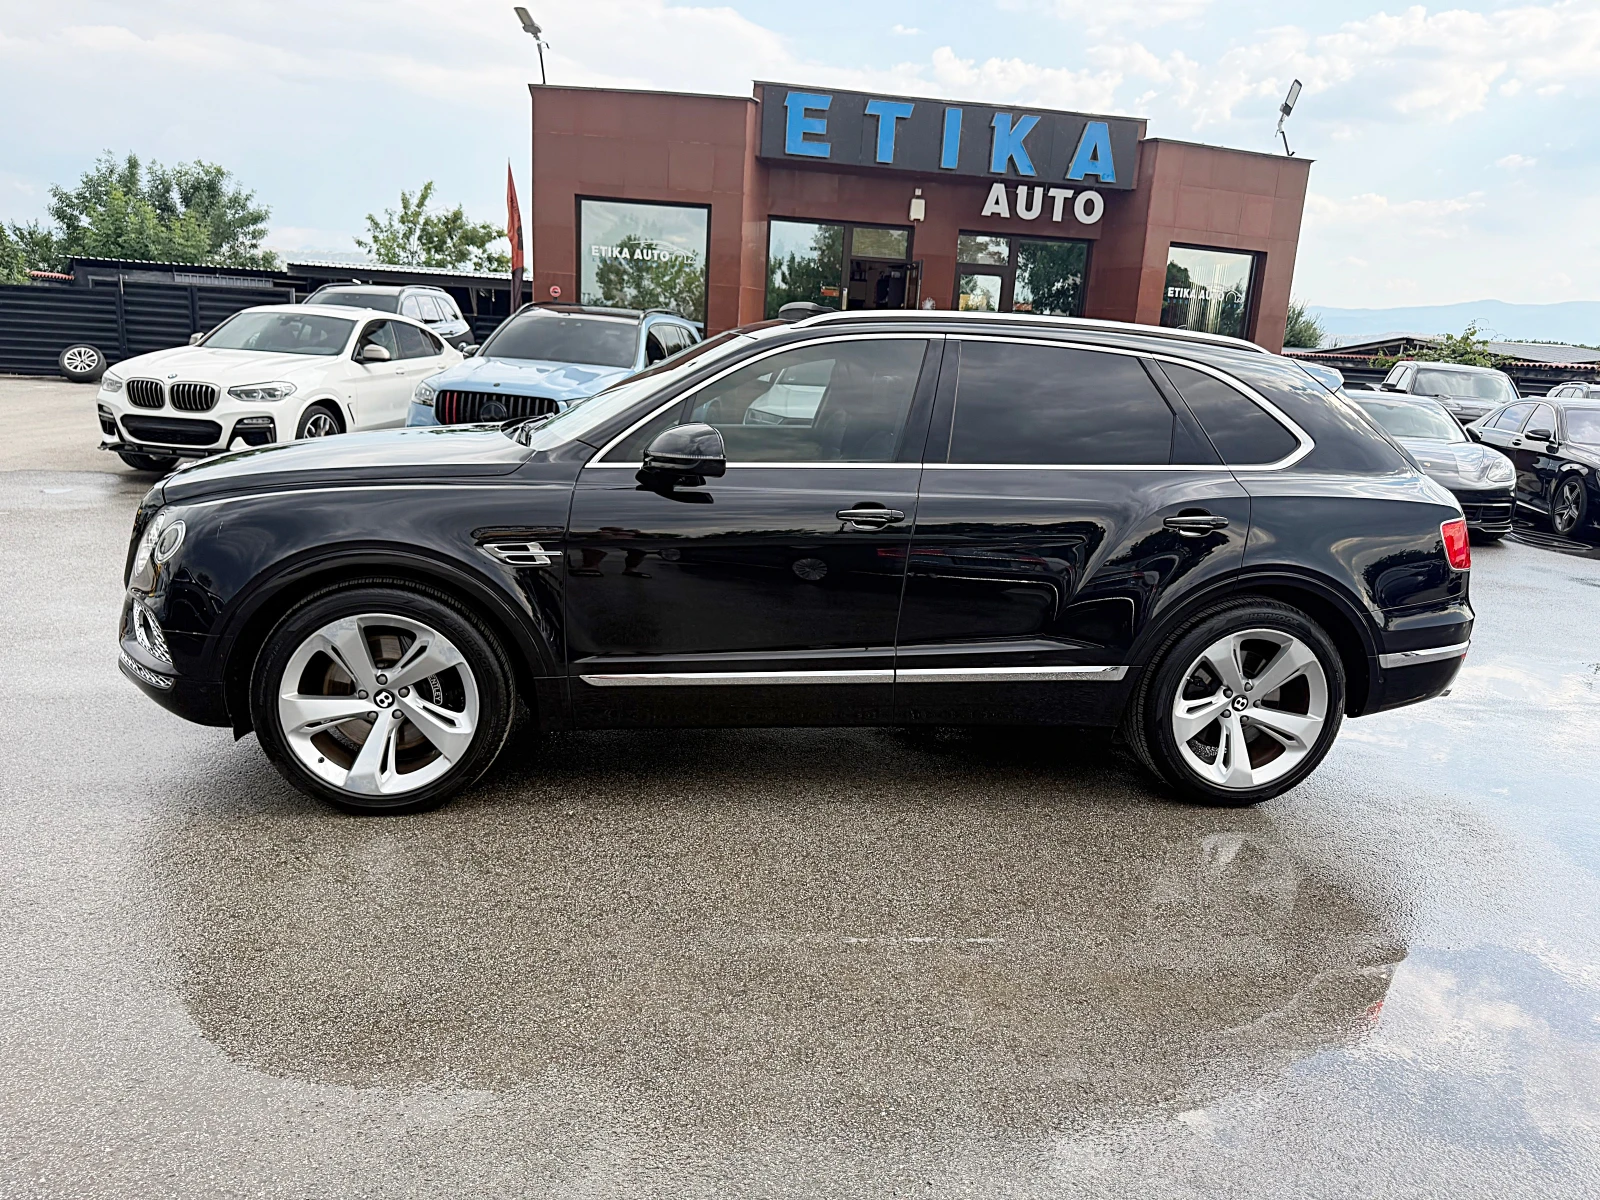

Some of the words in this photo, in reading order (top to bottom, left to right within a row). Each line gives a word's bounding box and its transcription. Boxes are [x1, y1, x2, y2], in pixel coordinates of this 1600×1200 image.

[784, 91, 1117, 183] ETIKA
[981, 182, 1105, 226] AUTO
[591, 245, 630, 259] ETIKA
[633, 248, 670, 262] AUTO
[1167, 286, 1196, 299] ETIKA
[1198, 289, 1224, 301] AUTO
[430, 673, 441, 701] ENTLEY
